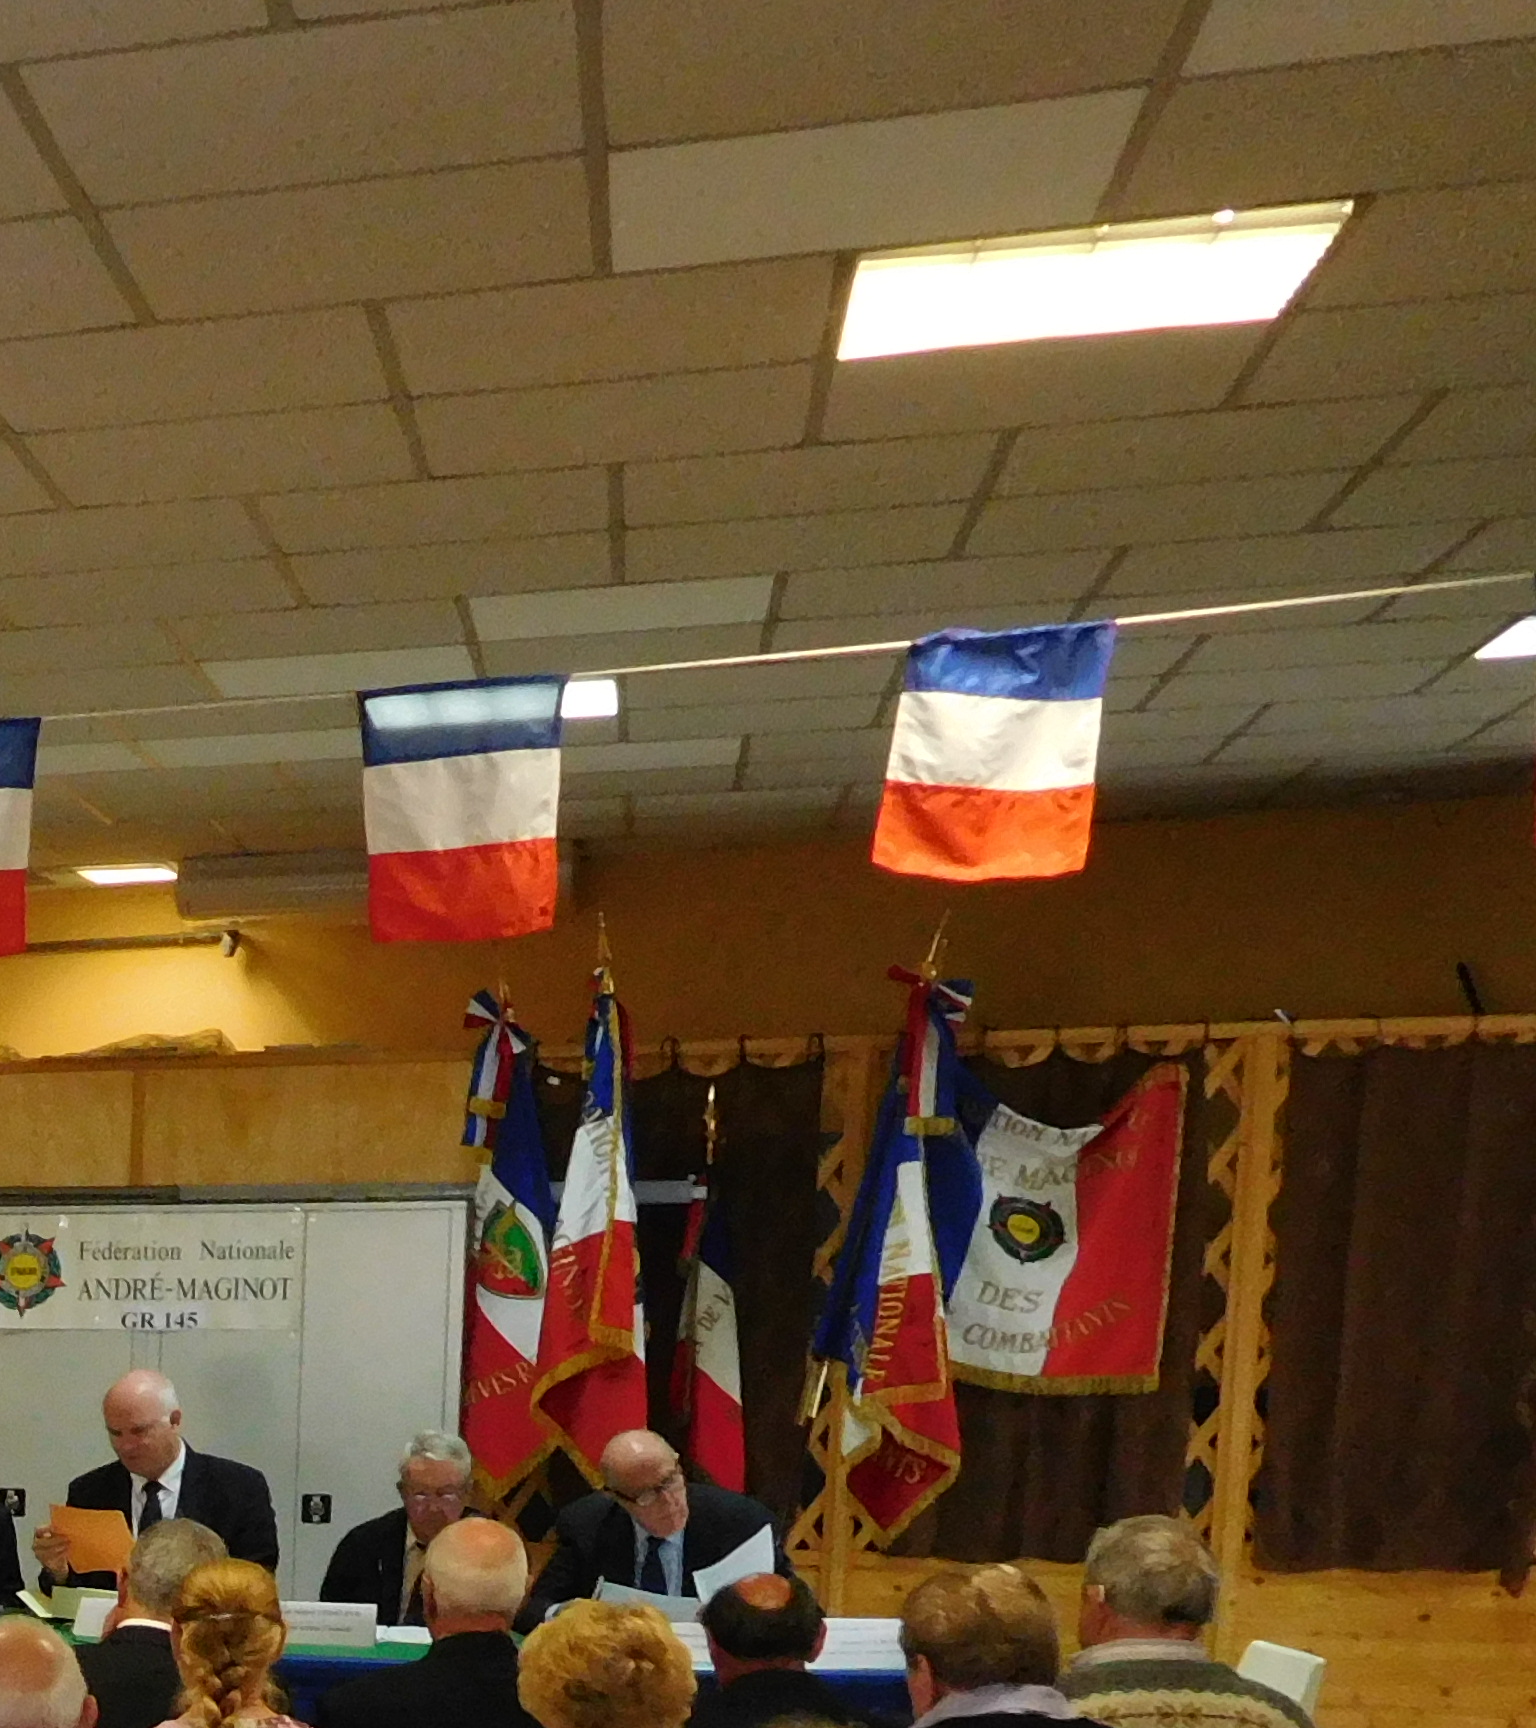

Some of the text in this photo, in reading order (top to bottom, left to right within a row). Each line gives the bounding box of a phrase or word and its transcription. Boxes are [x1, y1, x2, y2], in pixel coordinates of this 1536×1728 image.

[78, 1240, 295, 1262] Fédération Nationale
[77, 1271, 294, 1302] ANDRÉ-MAGINOT
[978, 1279, 1045, 1314] DES
[120, 1311, 199, 1330] GR 145
